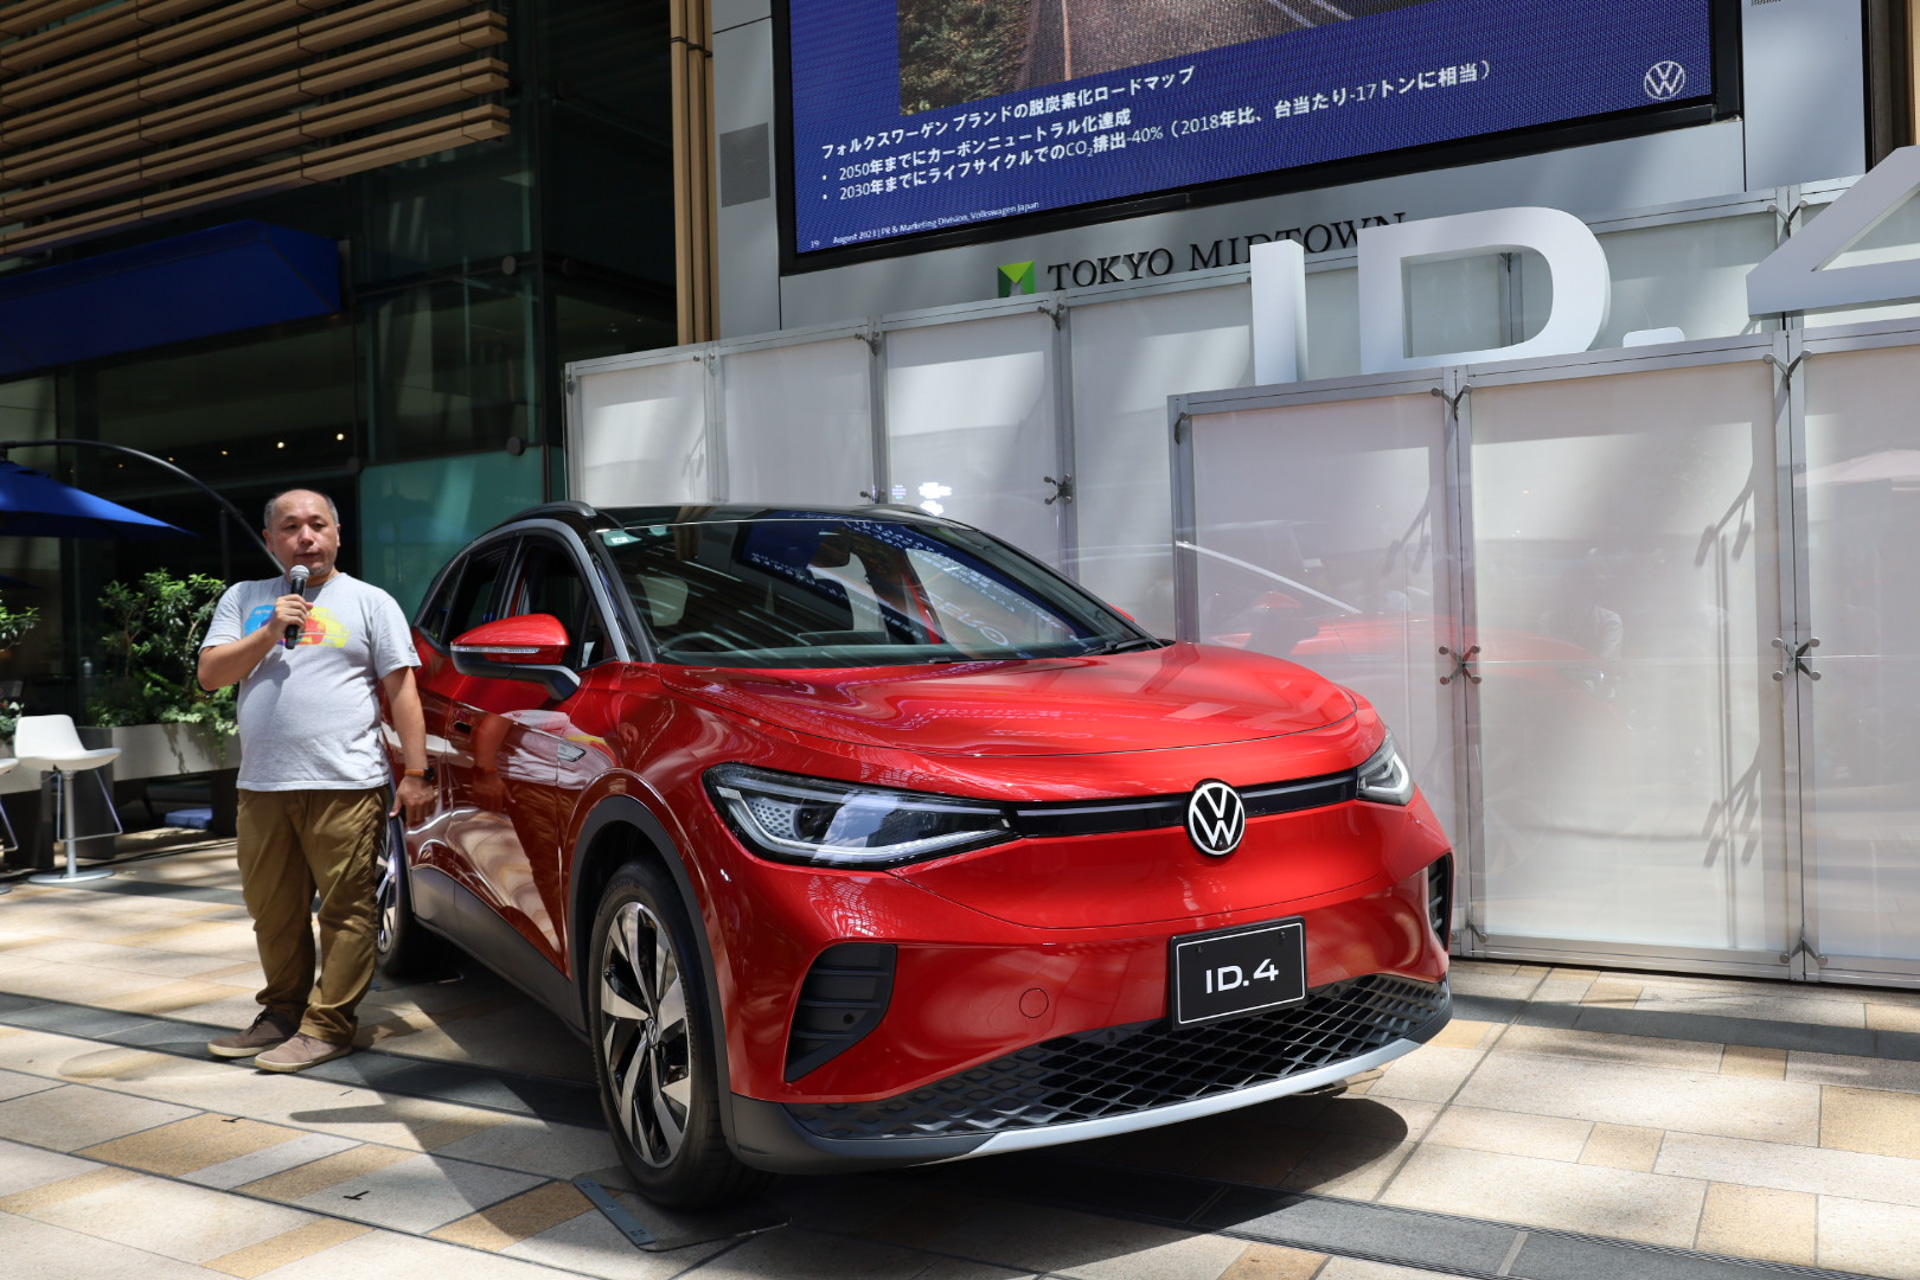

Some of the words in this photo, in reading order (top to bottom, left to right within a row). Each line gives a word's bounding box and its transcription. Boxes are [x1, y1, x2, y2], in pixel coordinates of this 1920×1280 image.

[822, 122, 948, 159] フォルクスワーゲン
[953, 64, 1195, 132] ブランドの脱炭素化ロードマップ
[839, 108, 1131, 181] 2050年までにカーボンニュートラル化達成
[810, 240, 820, 249] 19
[833, 233, 857, 245] August
[881, 226, 891, 236] PR
[892, 225, 898, 233] &
[900, 220, 937, 232] Marketing
[970, 206, 1016, 219] Volkswagen
[1017, 201, 1039, 213] Japan
[1047, 248, 1174, 291] TOKYO
[1206, 958, 1279, 994] ID.4
